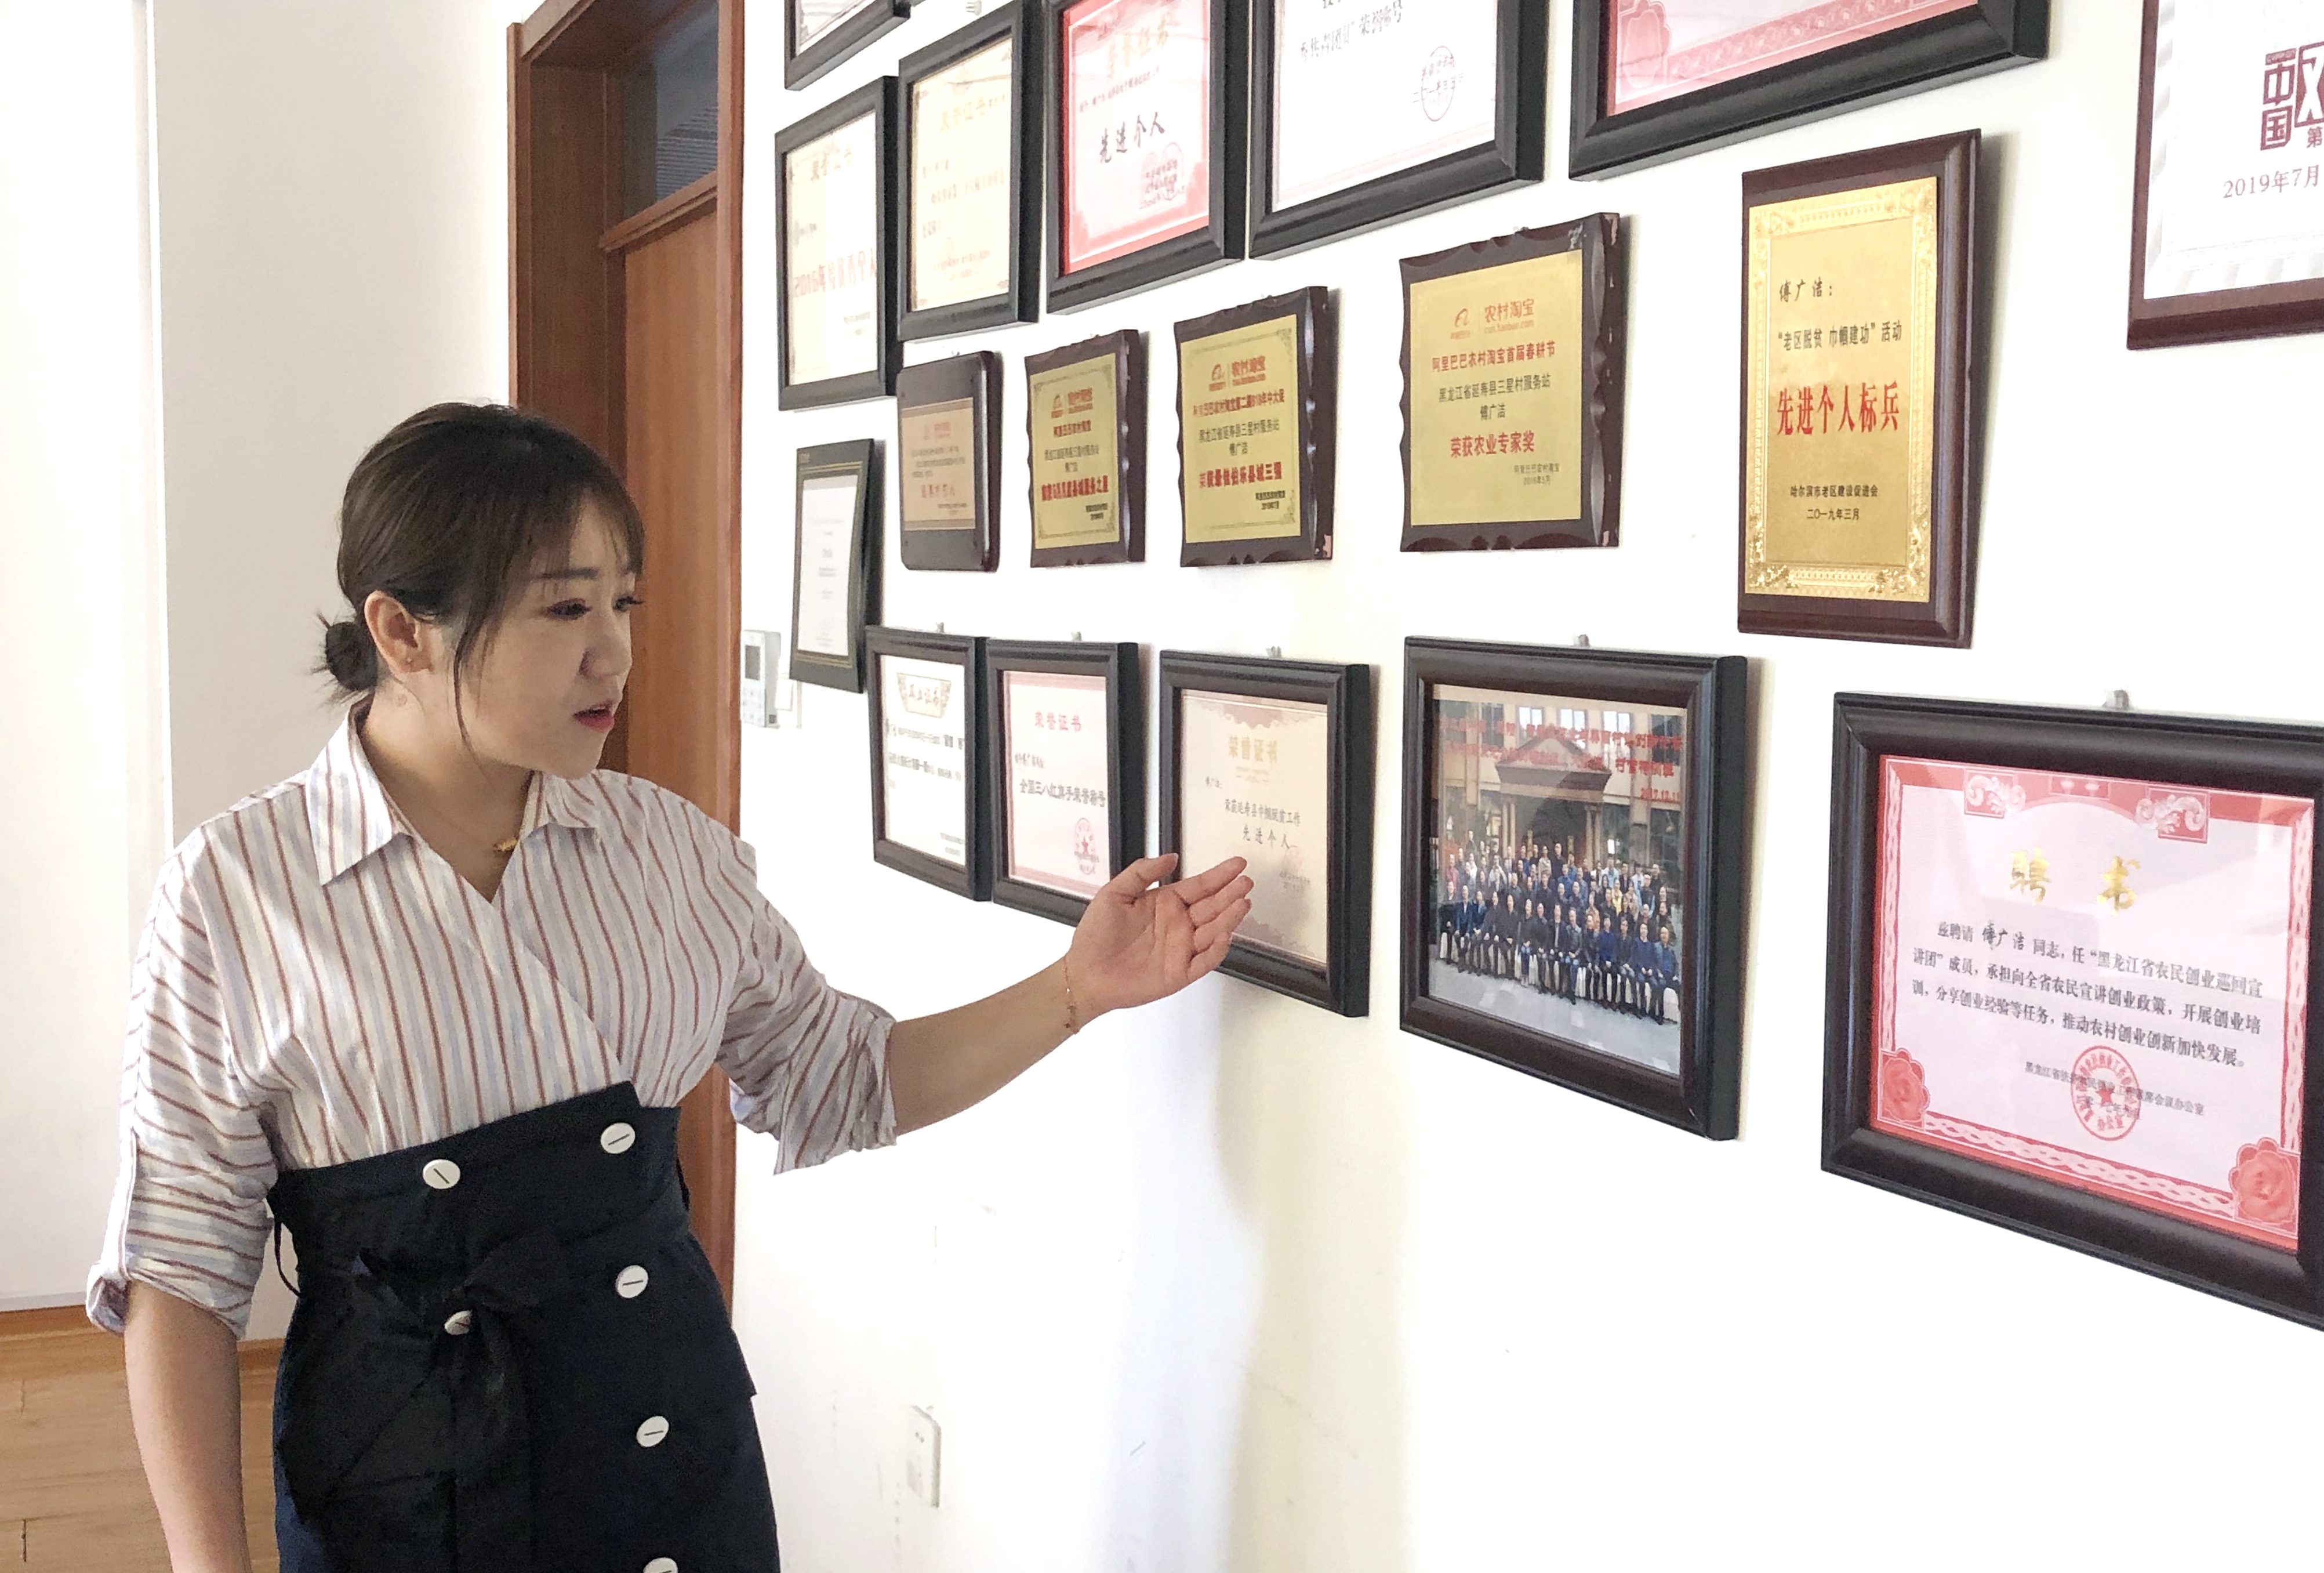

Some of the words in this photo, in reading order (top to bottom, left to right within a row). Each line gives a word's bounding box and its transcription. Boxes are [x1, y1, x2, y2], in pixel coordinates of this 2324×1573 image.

[1100, 112, 1165, 163] 先进个人
[2223, 165, 2320, 198] 2019年7月
[1484, 298, 1535, 322] 农村淘宝
[1881, 320, 1902, 342] 活动
[1432, 340, 1556, 373] 阿里巴巴农村淘宝首届春耕节
[1439, 374, 1551, 403] 黑龙江省延寿县三星村服务站
[1777, 380, 1900, 436] 先进个人标兵
[1450, 429, 1535, 458] 荣获农业专家奖
[1790, 484, 1879, 499] 哈尔滨市老区建设促进会
[1242, 824, 1291, 849] 先进个人
